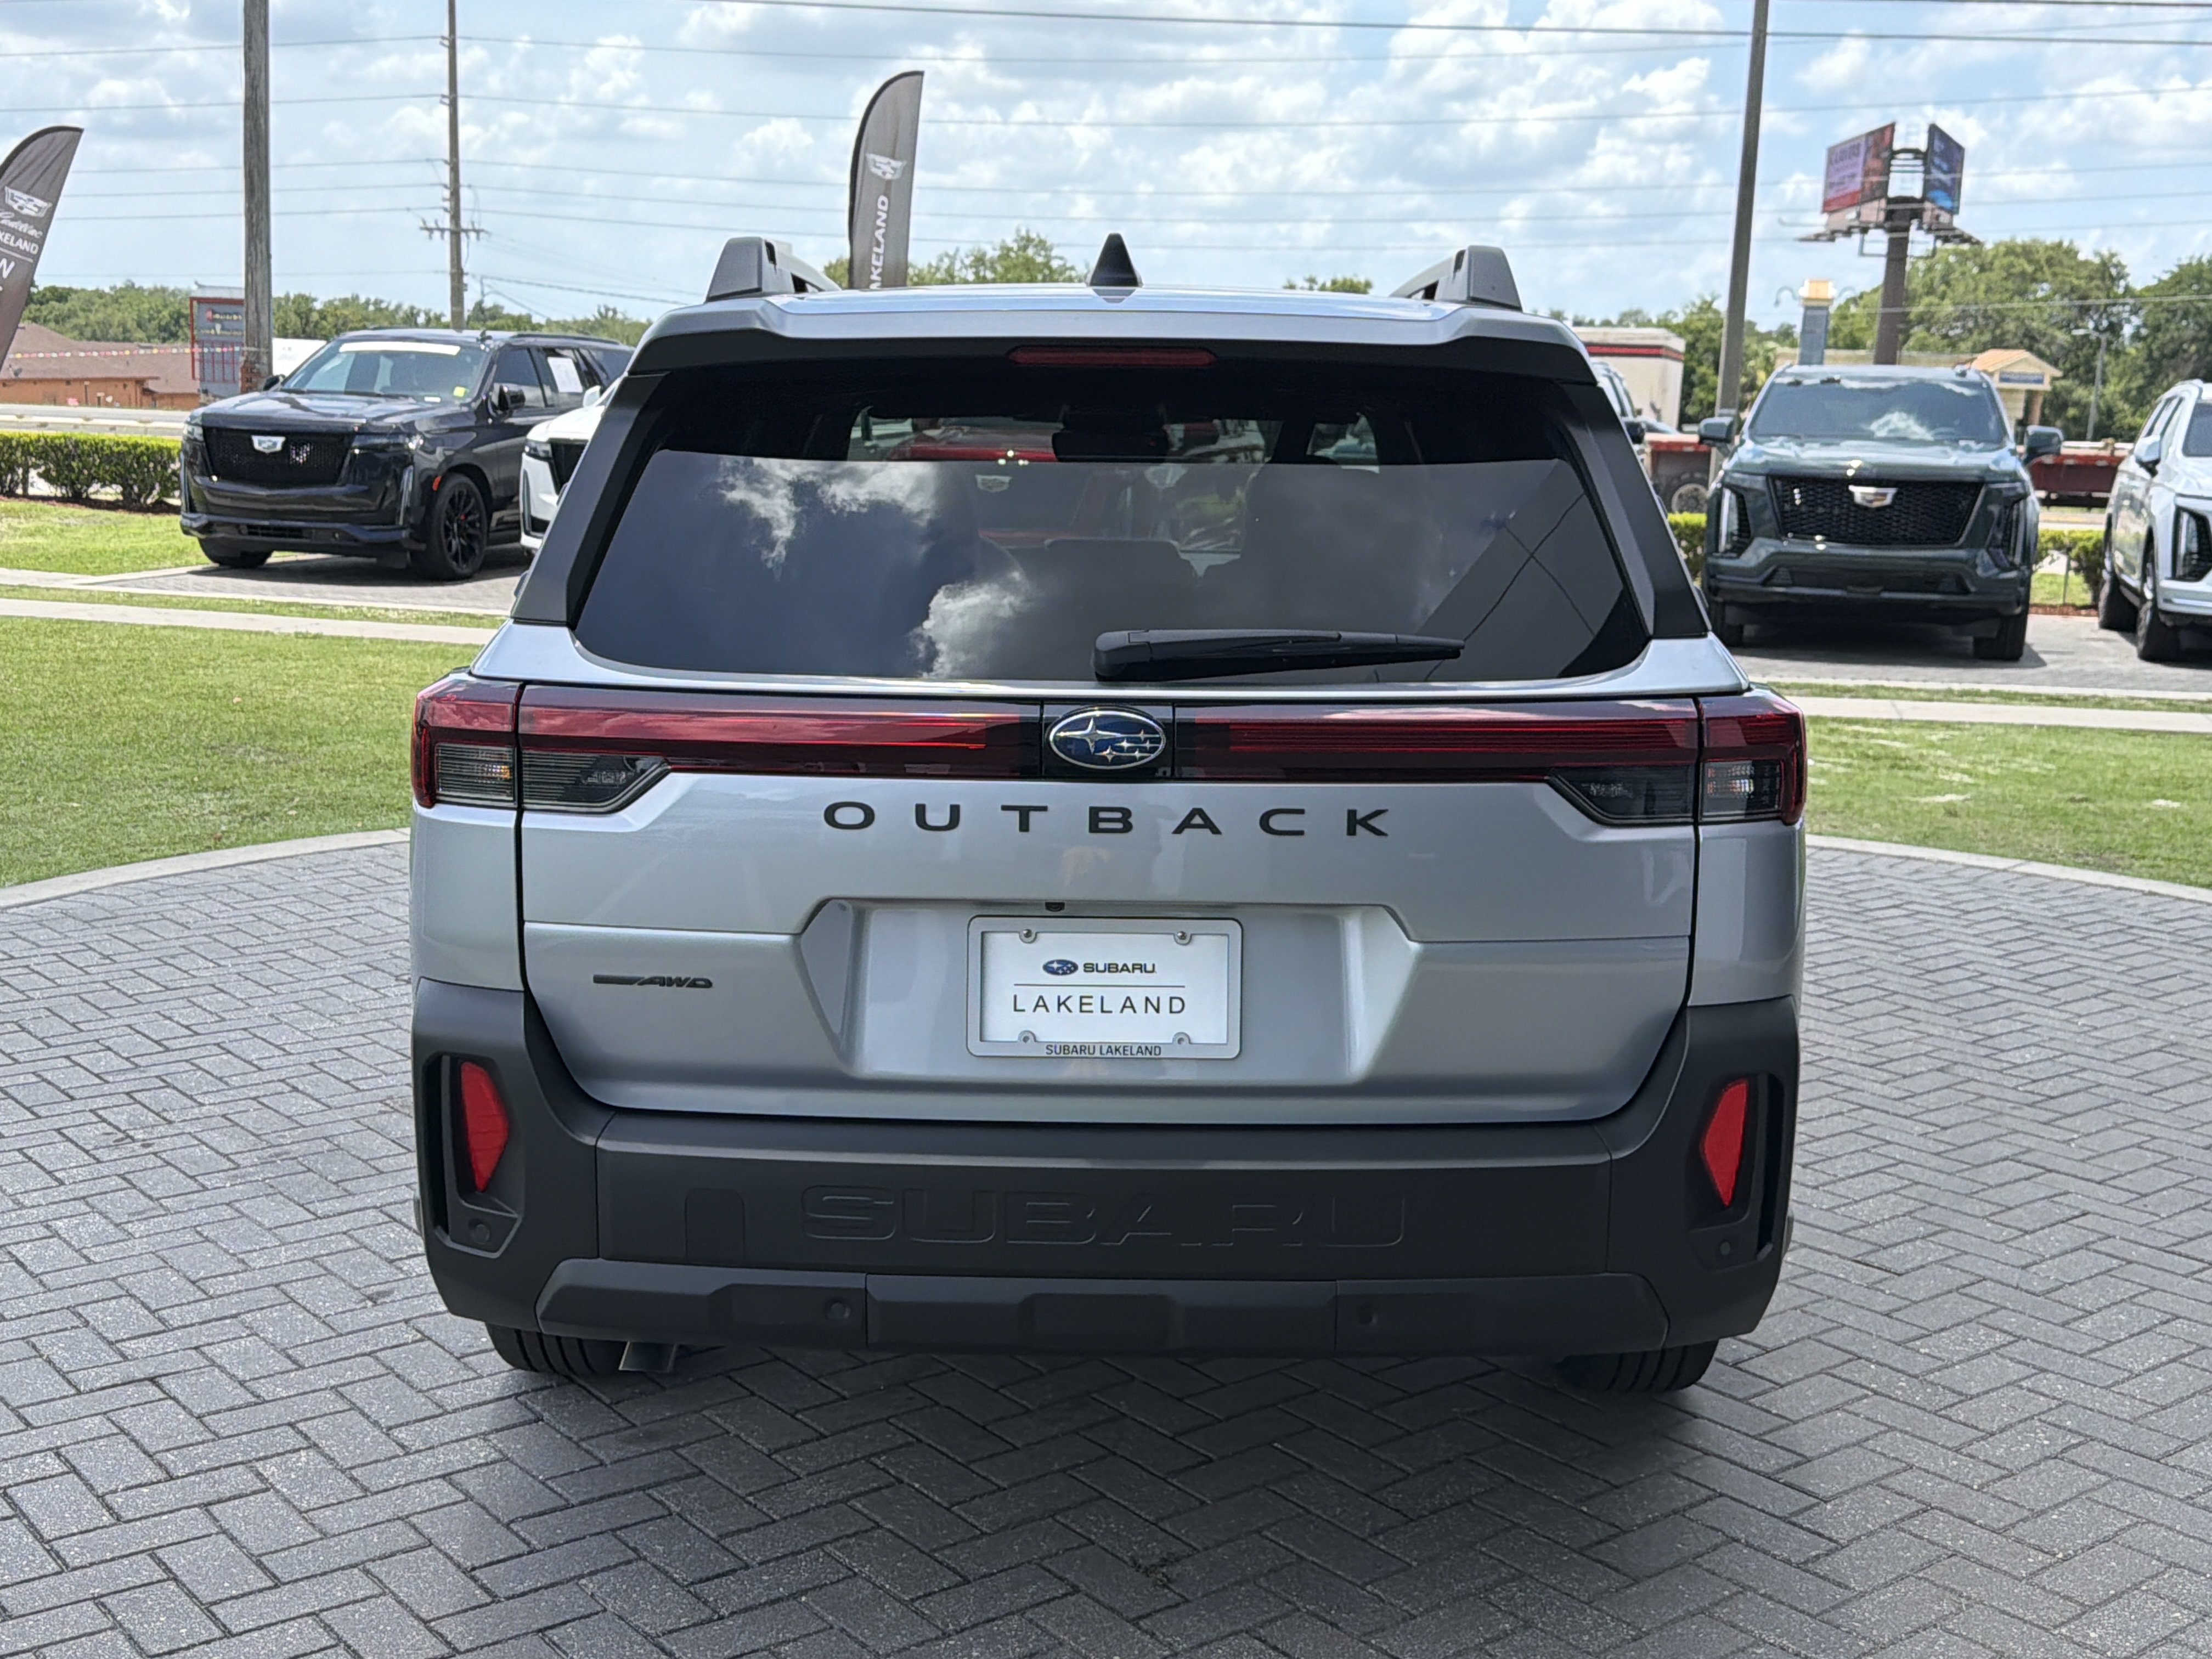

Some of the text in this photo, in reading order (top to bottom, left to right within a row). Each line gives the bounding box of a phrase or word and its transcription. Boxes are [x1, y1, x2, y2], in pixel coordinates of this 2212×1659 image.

[823, 801, 1389, 837] OUTBACK
[1083, 962, 1155, 973] SUBARU
[637, 976, 713, 989] AWD
[1013, 994, 1186, 1014] LAKELAND
[1046, 1044, 1161, 1057] SUBARU LAKELAND
[801, 1185, 1406, 1248] SUBARU
